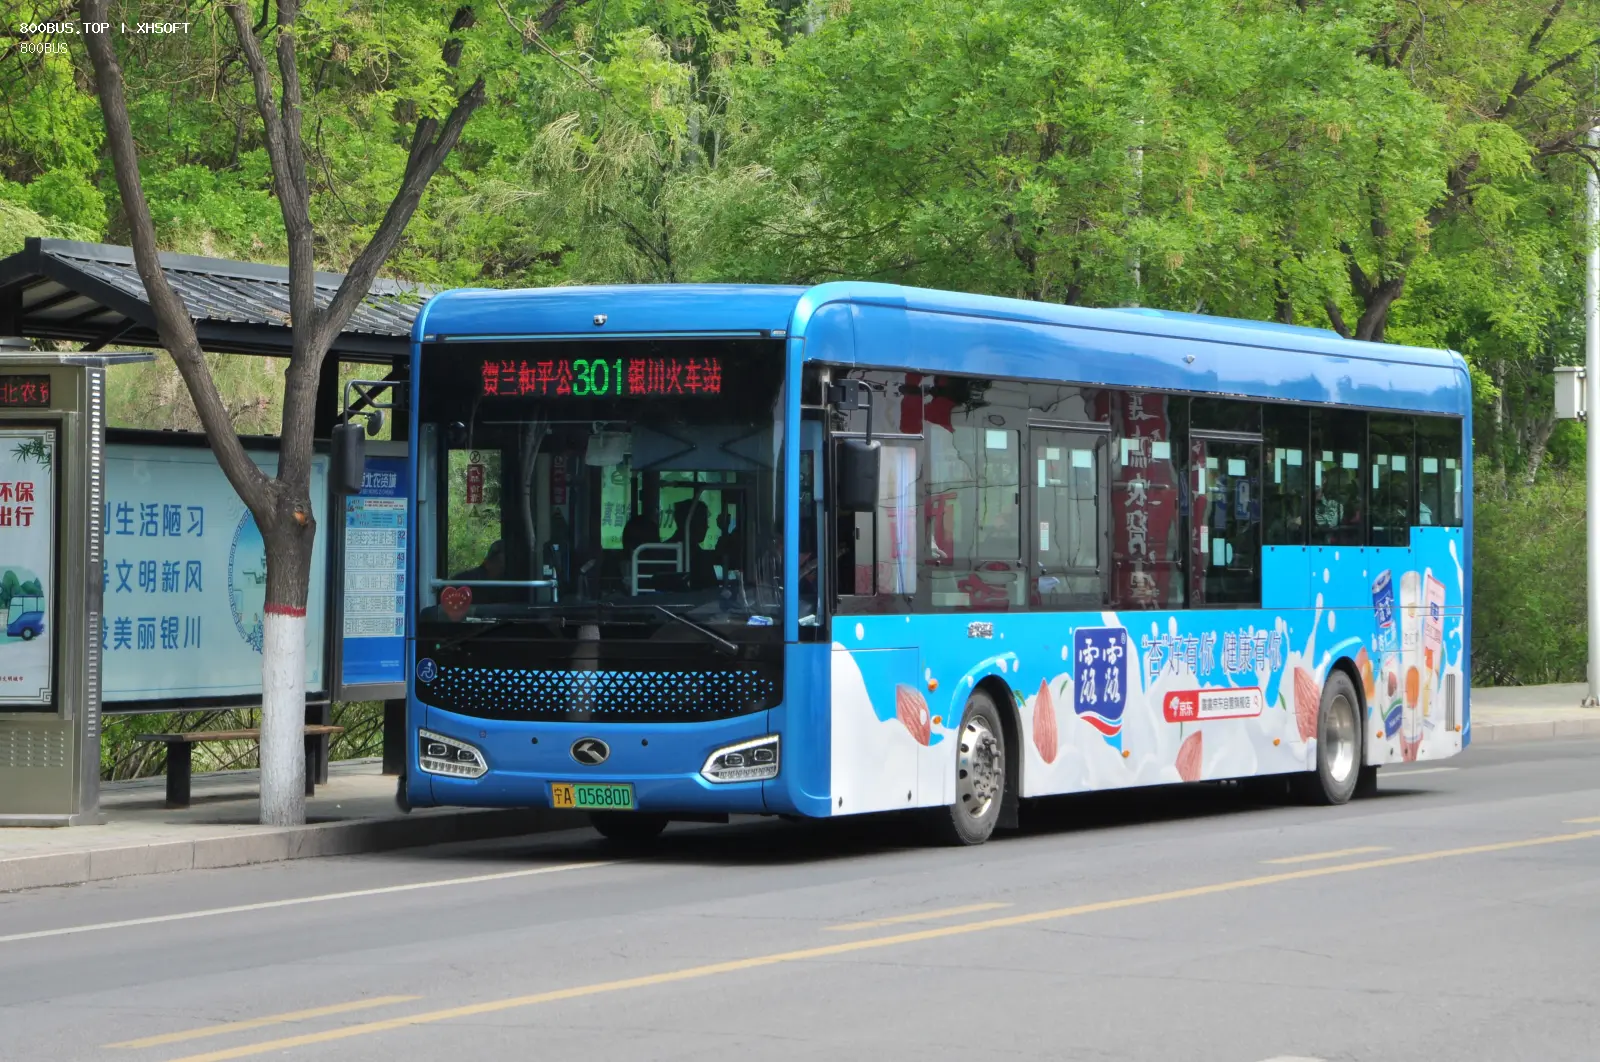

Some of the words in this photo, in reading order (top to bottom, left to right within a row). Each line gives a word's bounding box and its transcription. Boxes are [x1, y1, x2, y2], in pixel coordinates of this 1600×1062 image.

[482, 359, 572, 396] 贺兰和平公
[572, 358, 622, 396] 301
[628, 357, 721, 395] 银川火车站
[1222, 629, 1282, 675] 健康有你
[1179, 701, 1194, 717] 京东
